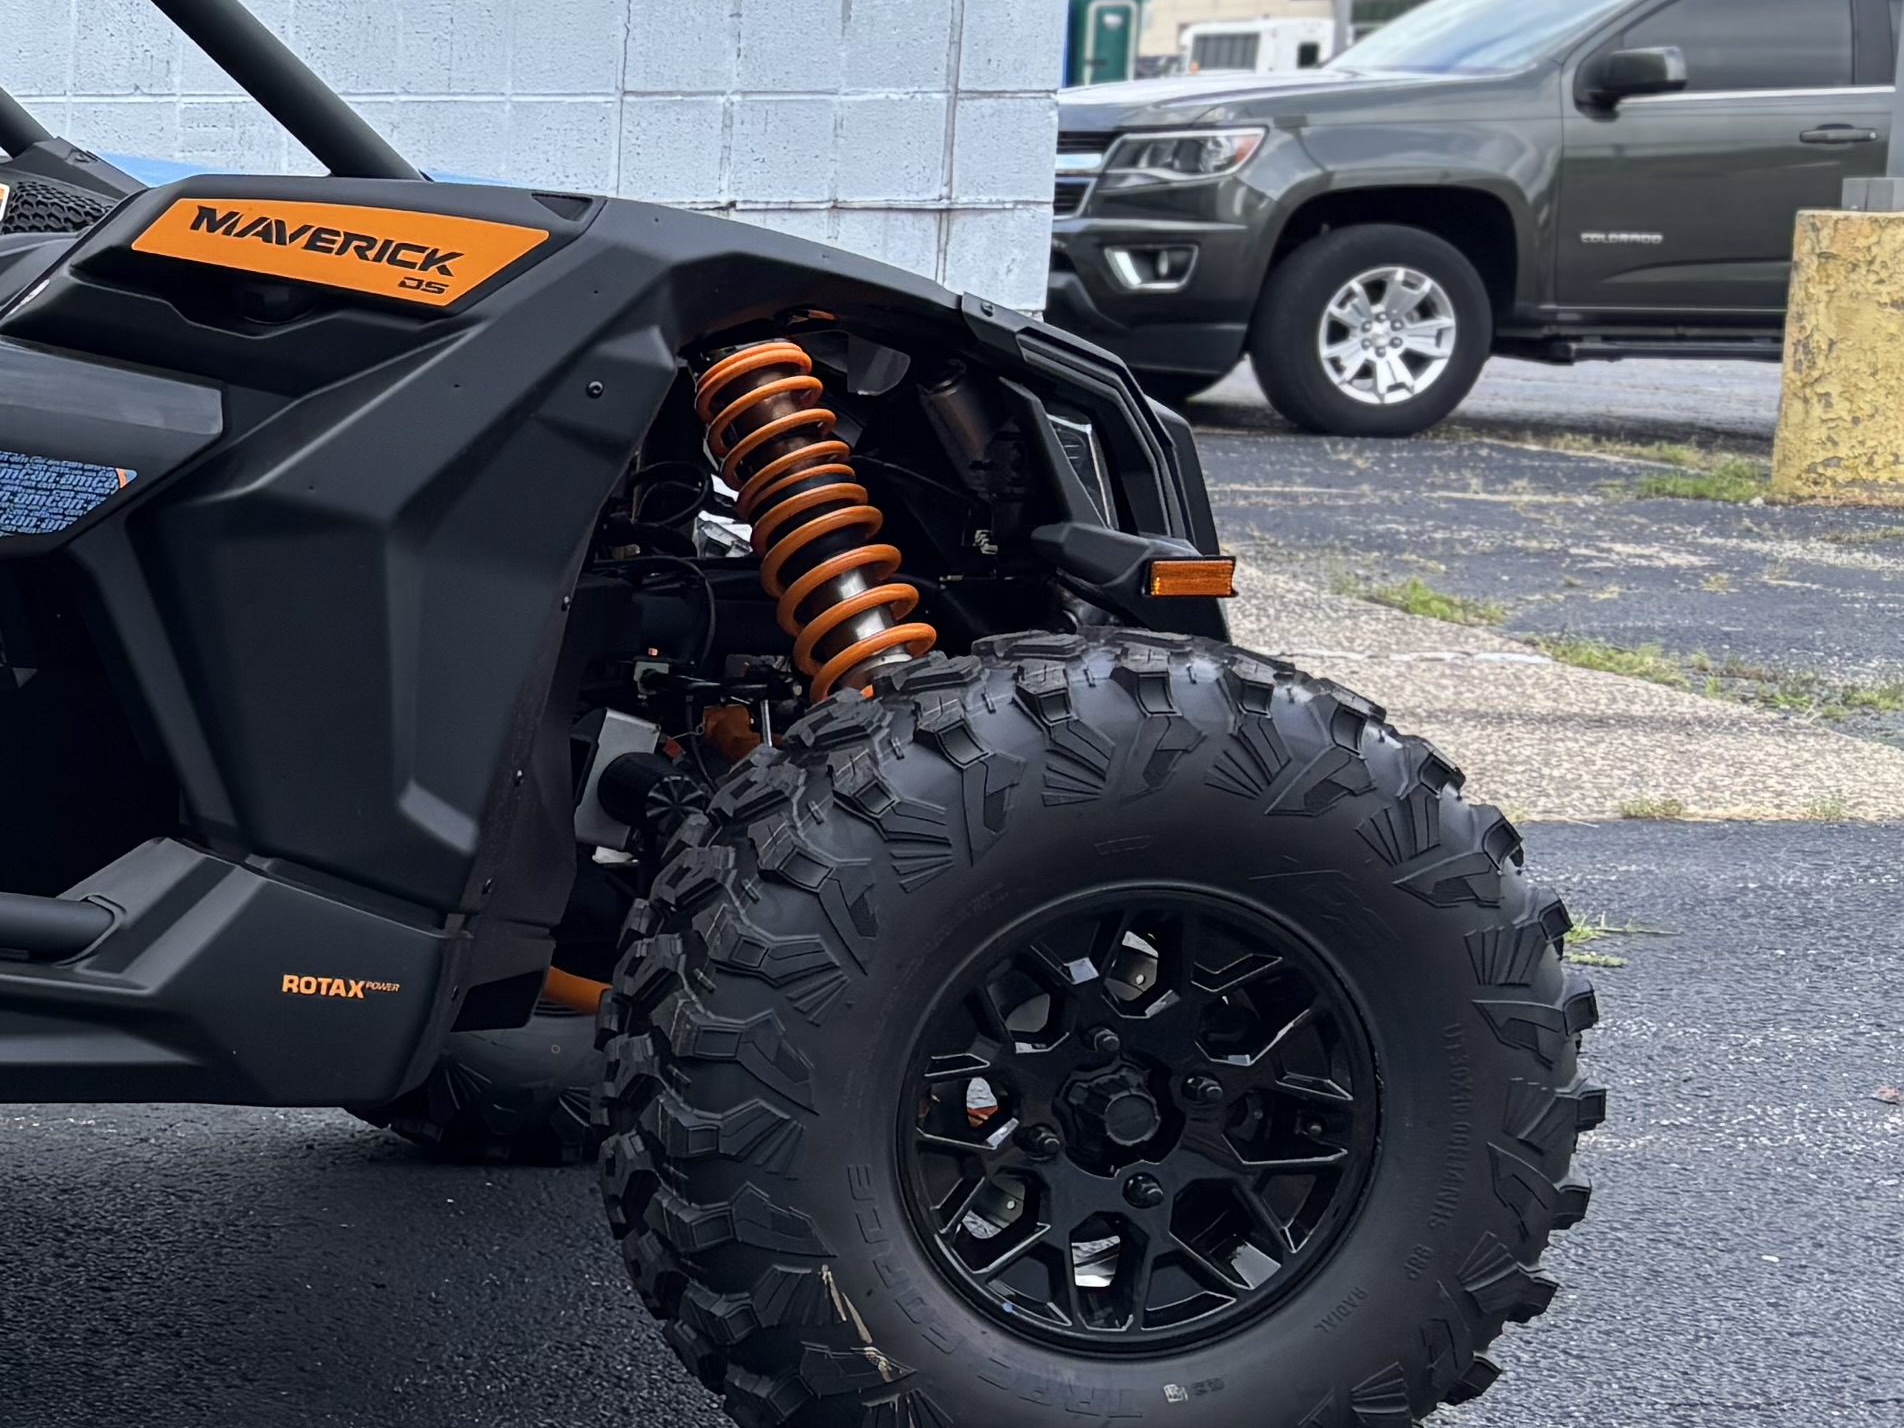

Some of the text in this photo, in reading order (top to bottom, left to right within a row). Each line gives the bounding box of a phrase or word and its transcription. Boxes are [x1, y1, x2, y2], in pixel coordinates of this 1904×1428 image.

[188, 205, 466, 277] MAVERICK
[1580, 232, 1663, 244] COLORADO
[398, 277, 449, 295] DS
[282, 974, 400, 998] ROTAX POWER
[1312, 1283, 1368, 1341] RADIAL
